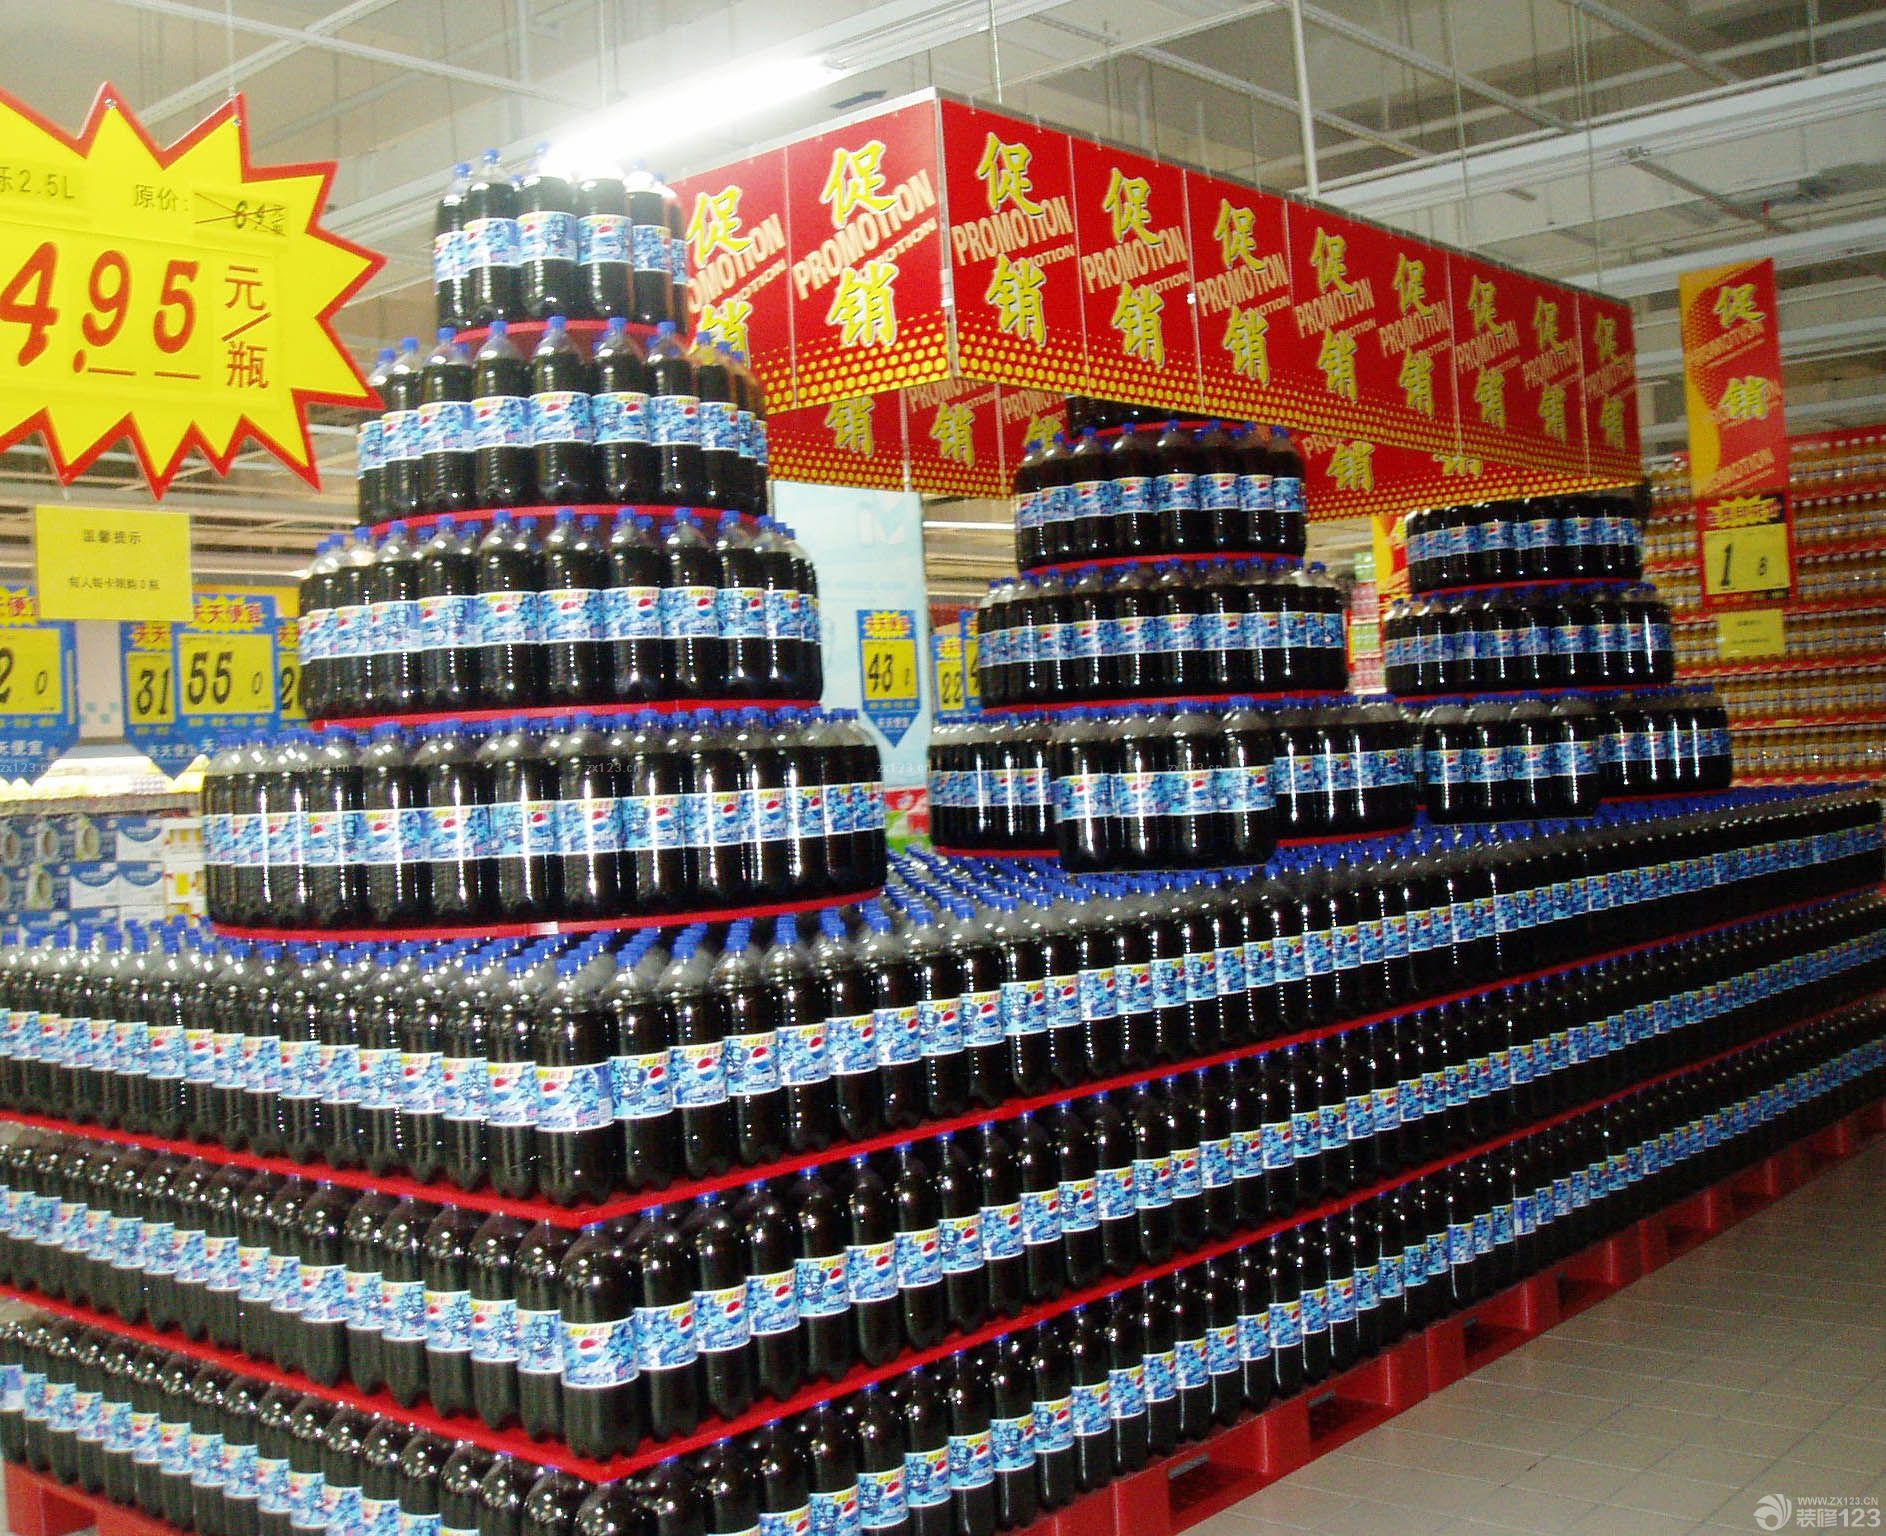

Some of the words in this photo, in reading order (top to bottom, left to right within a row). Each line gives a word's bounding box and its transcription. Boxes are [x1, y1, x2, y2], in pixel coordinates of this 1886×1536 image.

[819, 139, 900, 229] 促
[977, 132, 1045, 213] 促
[1103, 168, 1164, 247] 促
[685, 185, 755, 268] 促
[793, 168, 936, 300] PROMOTION
[952, 196, 1073, 266] PROMOTION
[1082, 226, 1189, 293] PROMOTION
[1214, 198, 1266, 271] 促
[1311, 227, 1356, 295] 促
[826, 260, 899, 347] 销
[985, 253, 1046, 346] 销
[1196, 253, 1289, 316] PROMOTION
[1294, 277, 1375, 339] PROMOTION
[1393, 253, 1434, 318] 促
[1713, 284, 1767, 328] 促
[1112, 281, 1165, 369] 销
[1222, 304, 1269, 387] 销
[1318, 327, 1357, 404] 销
[1400, 346, 1435, 421] 销
[930, 402, 975, 466] 销
[1326, 440, 1375, 492] 销
